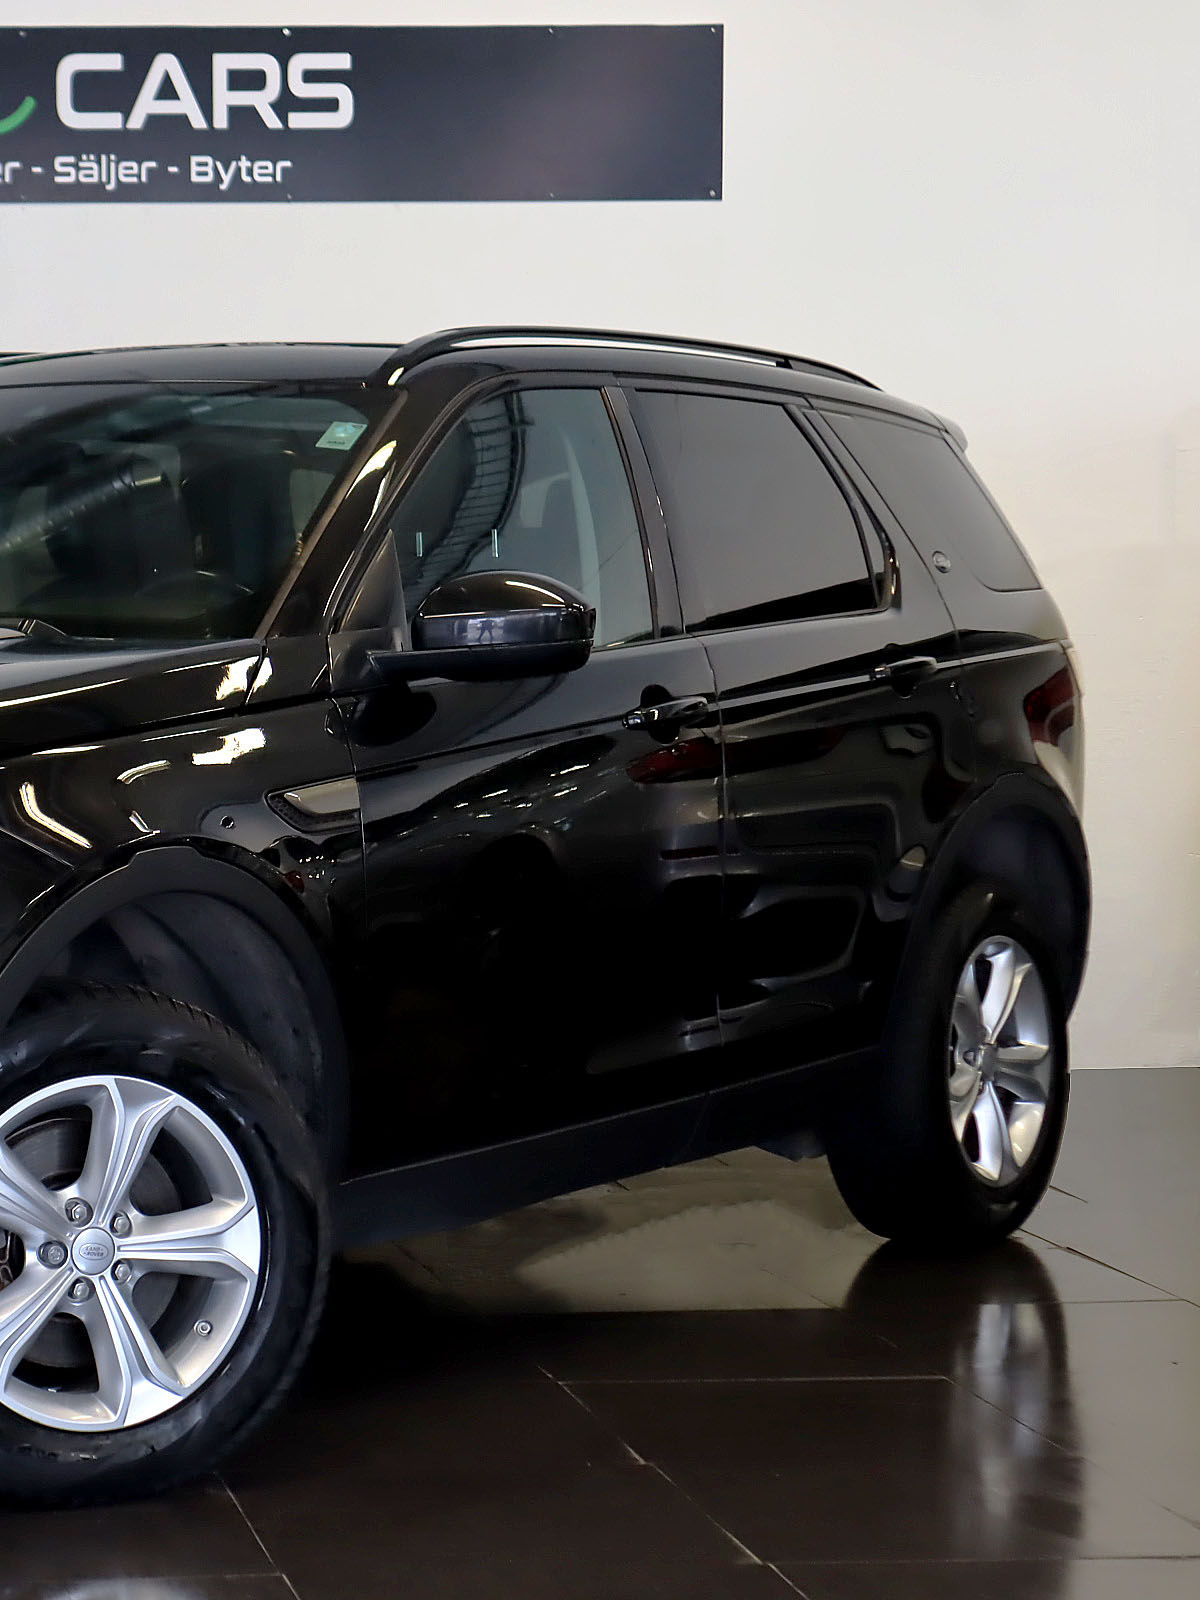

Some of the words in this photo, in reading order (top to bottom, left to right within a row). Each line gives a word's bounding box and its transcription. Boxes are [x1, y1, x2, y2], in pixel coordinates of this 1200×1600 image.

[55, 52, 355, 130] CARS
[53, 155, 157, 190] Säljer
[189, 155, 294, 190] Byter
